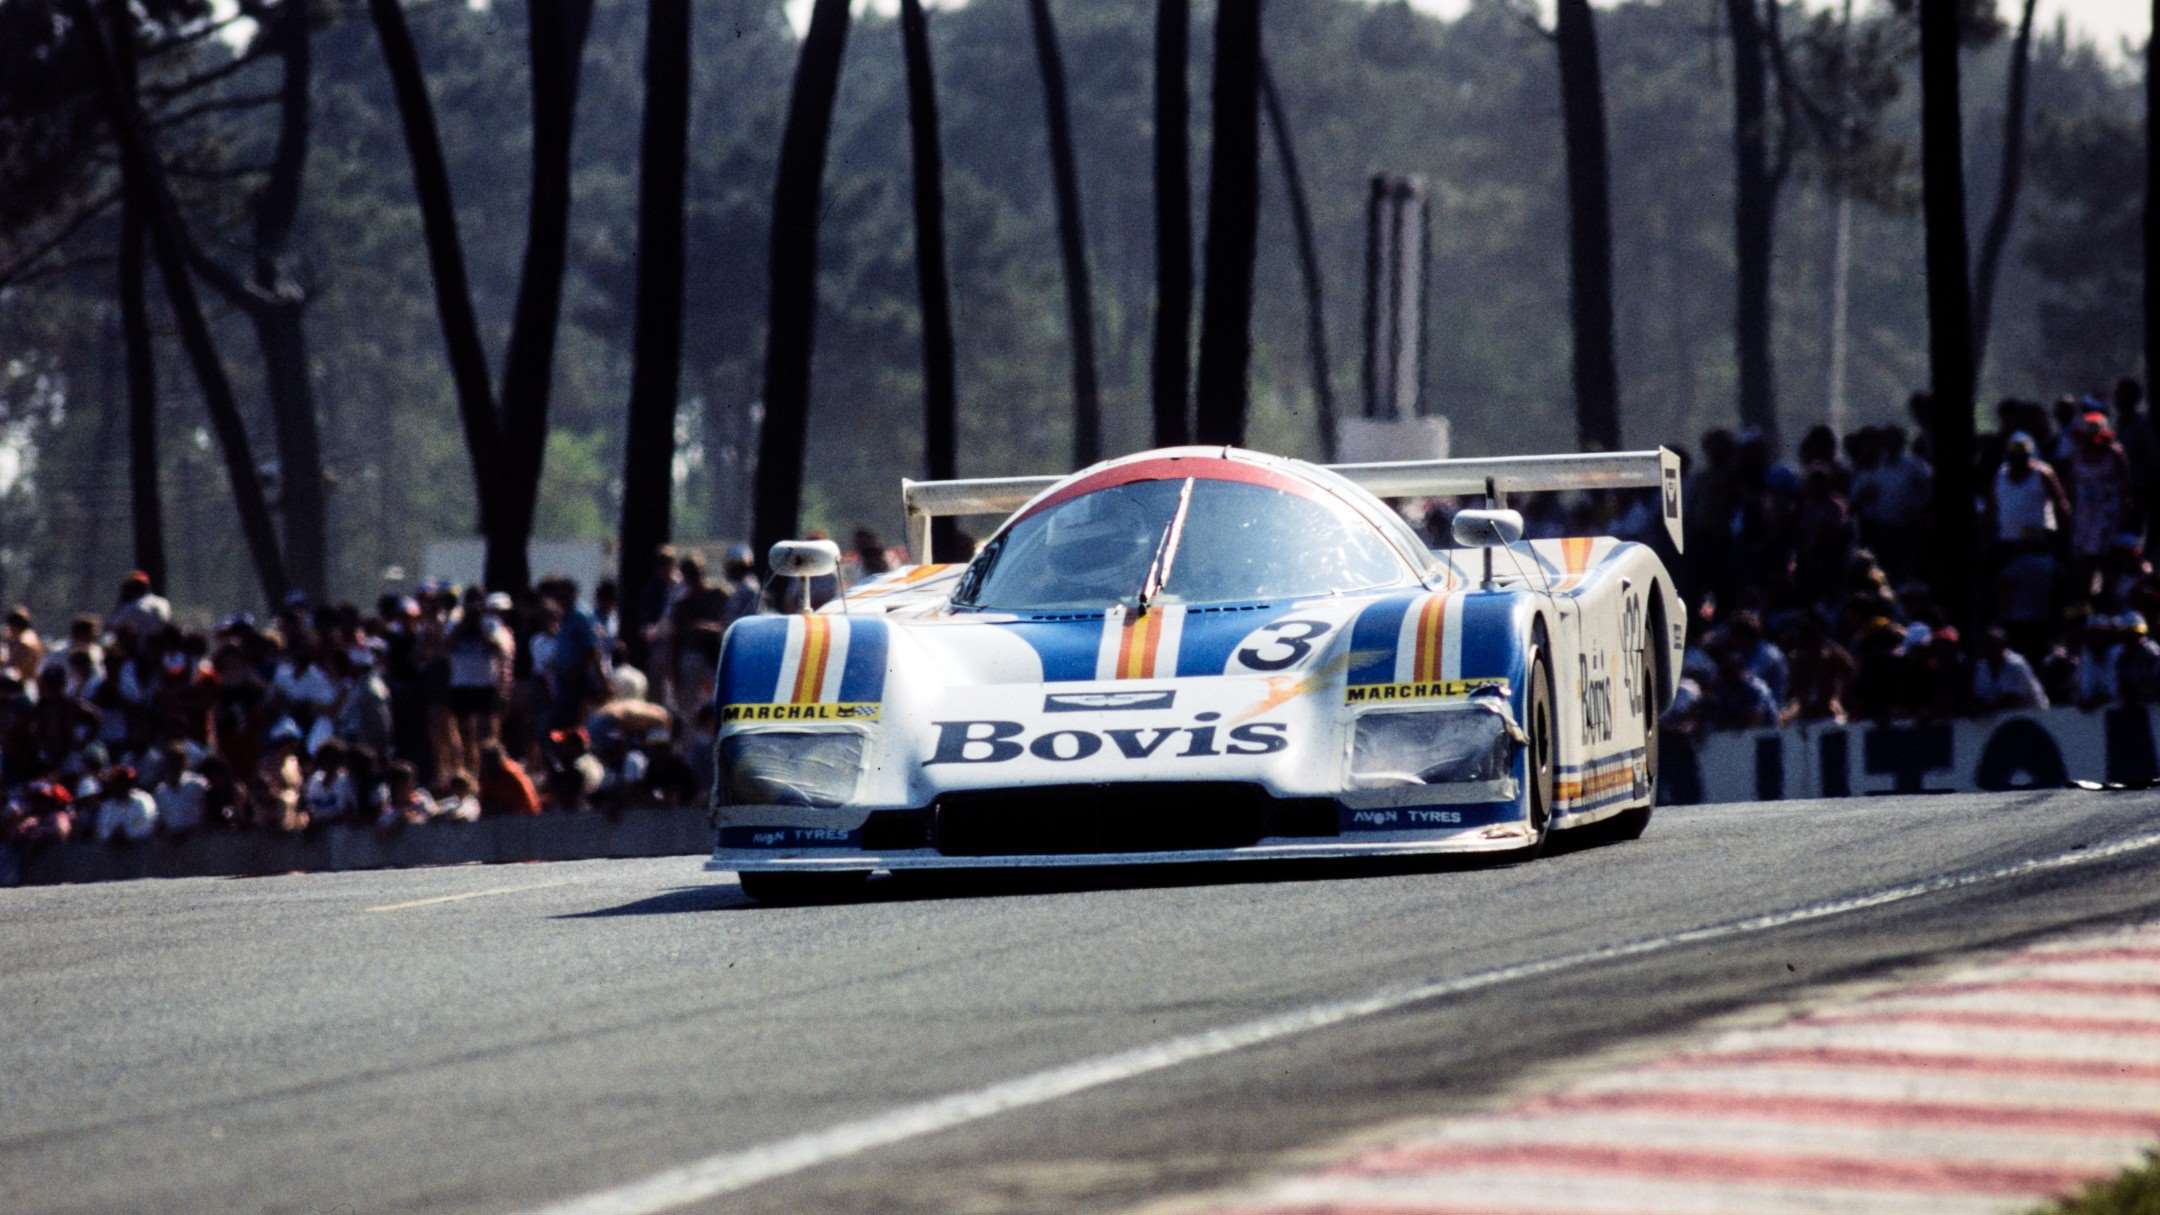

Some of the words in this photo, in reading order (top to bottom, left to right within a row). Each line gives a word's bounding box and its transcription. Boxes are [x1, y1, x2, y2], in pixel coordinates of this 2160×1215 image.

[1237, 619, 1333, 671] 3
[1346, 684, 1457, 701] MARCHAL
[722, 705, 830, 720] MARCHAL
[922, 711, 1289, 767] Bovis
[1354, 811, 1397, 824] AVON
[1407, 810, 1462, 823] TYRES
[794, 829, 848, 841] TYRES
